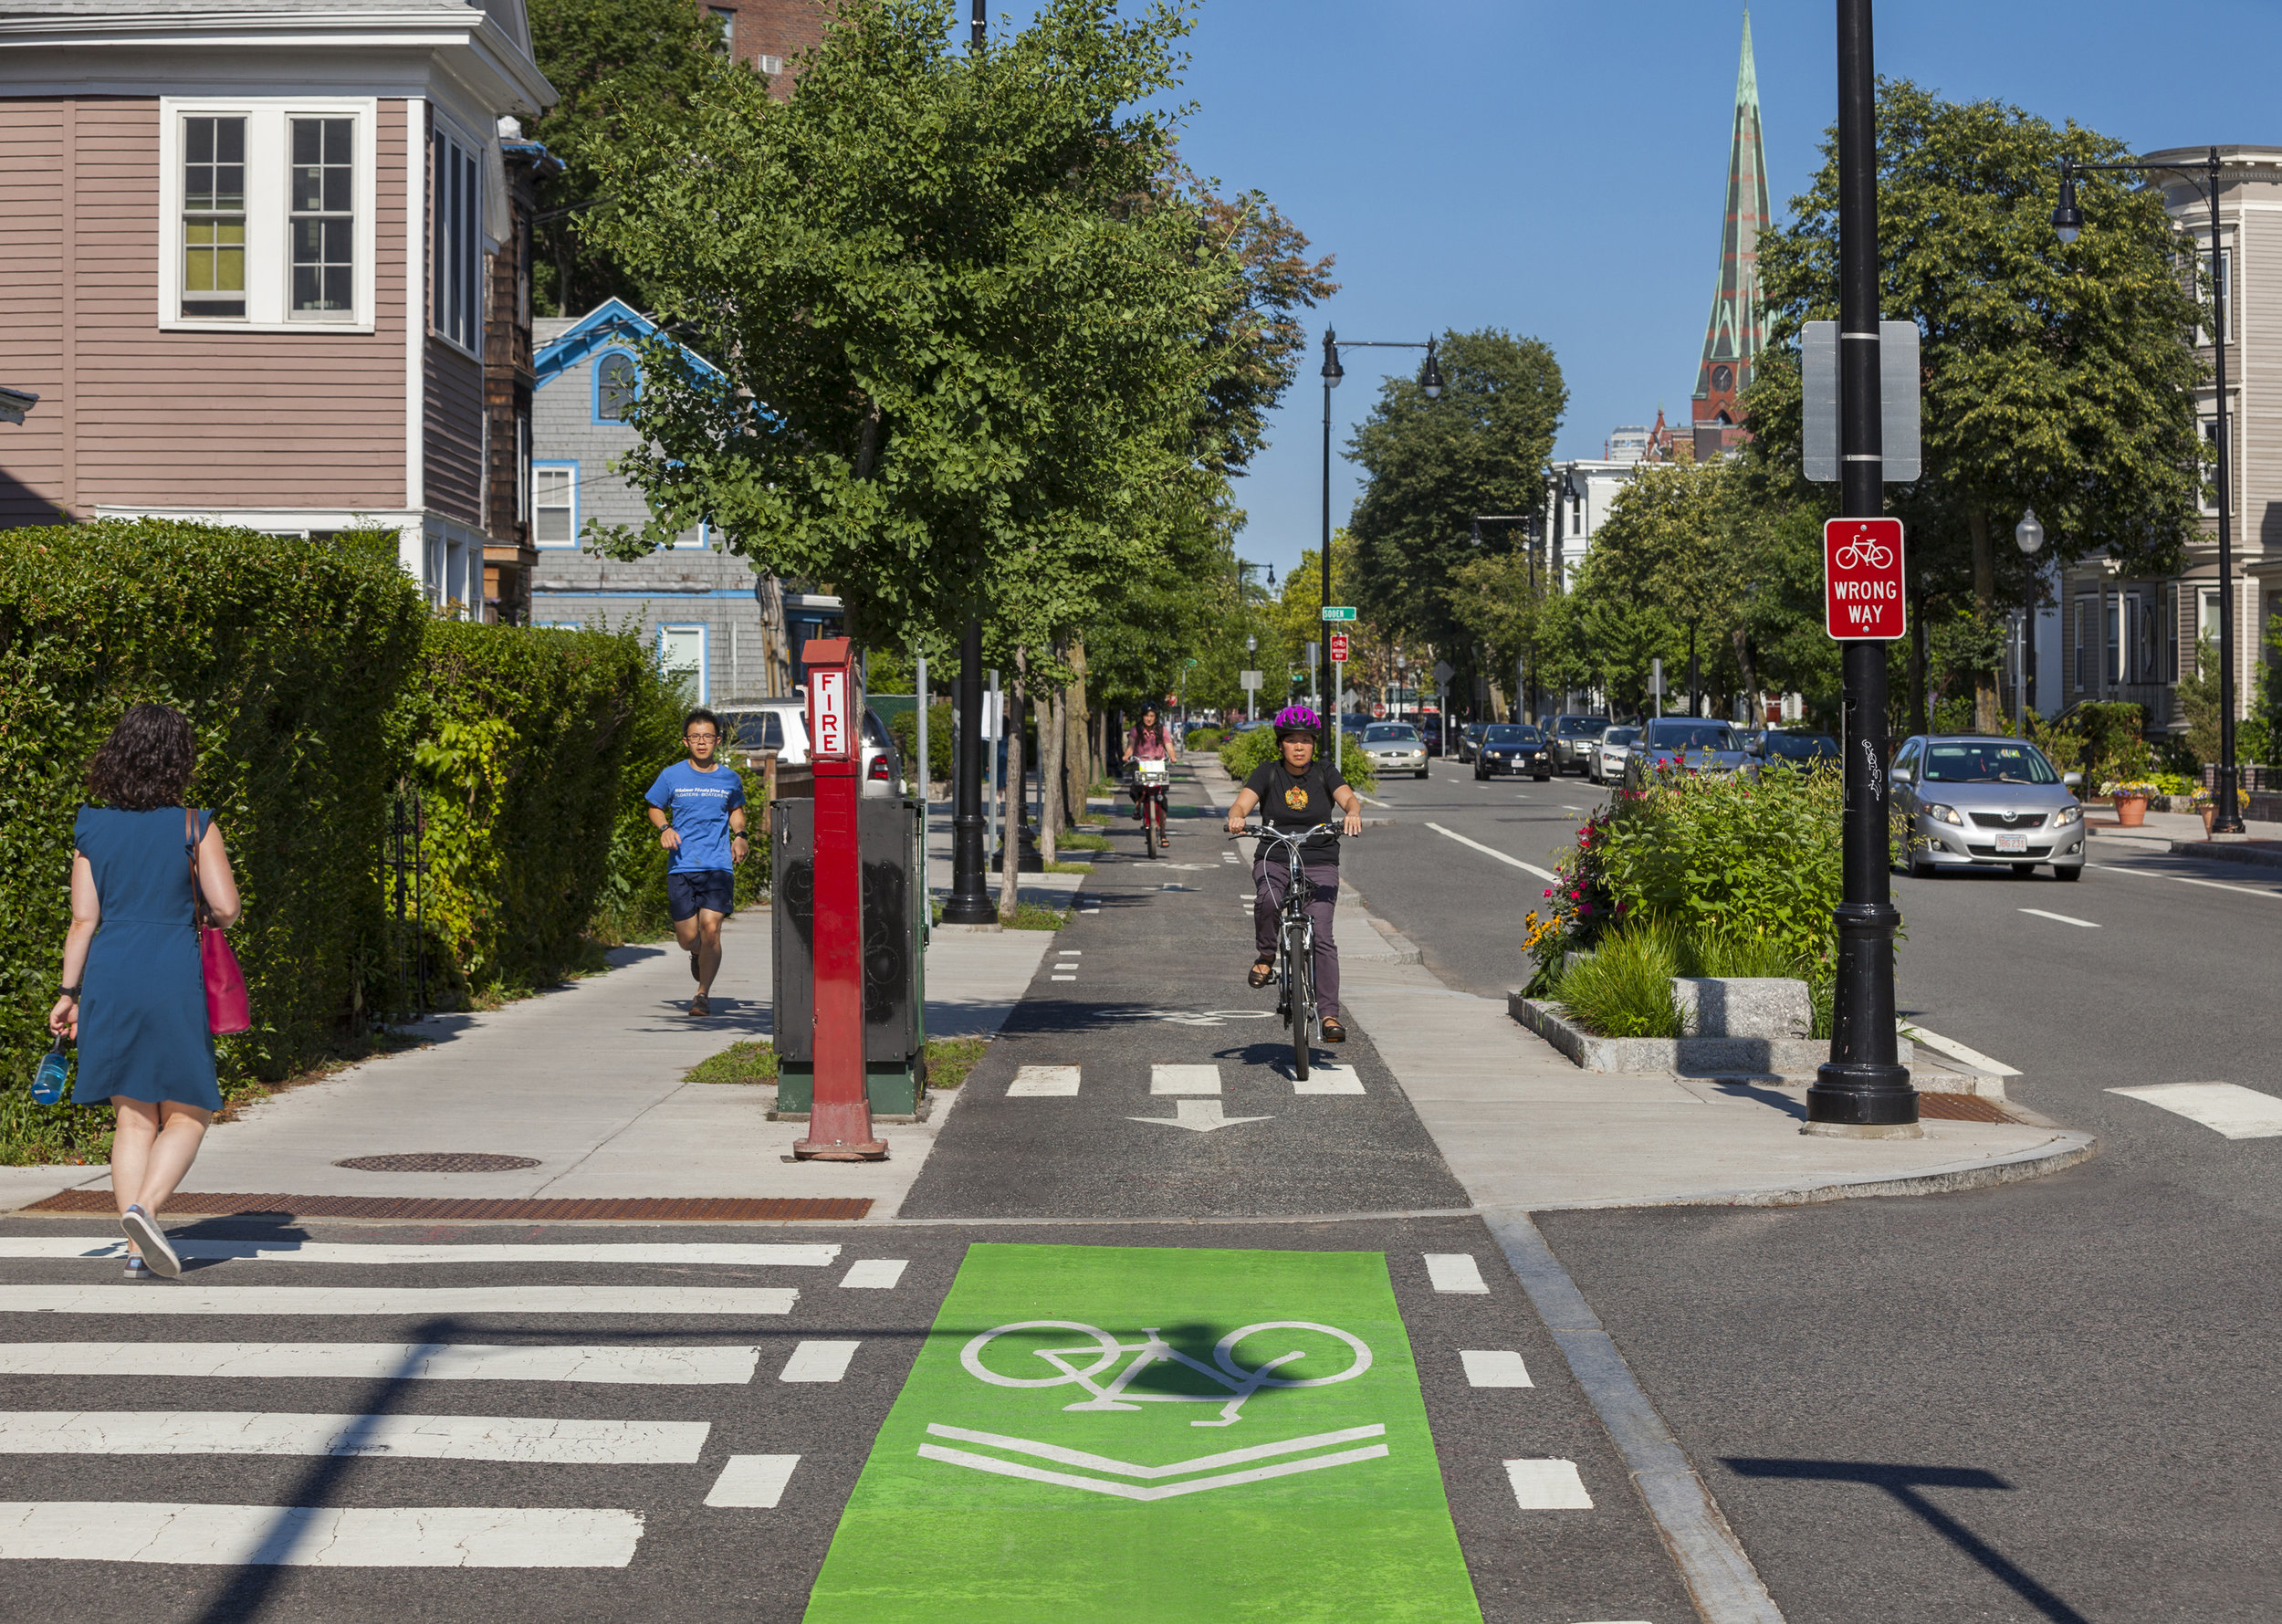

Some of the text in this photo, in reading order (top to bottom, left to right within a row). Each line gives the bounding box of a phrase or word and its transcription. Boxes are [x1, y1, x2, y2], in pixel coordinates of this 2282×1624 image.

[1834, 581, 1897, 600] WRONG
[1324, 609, 1345, 618] SODEN
[1848, 604, 1883, 623] WAY
[822, 675, 837, 751] FIRE
